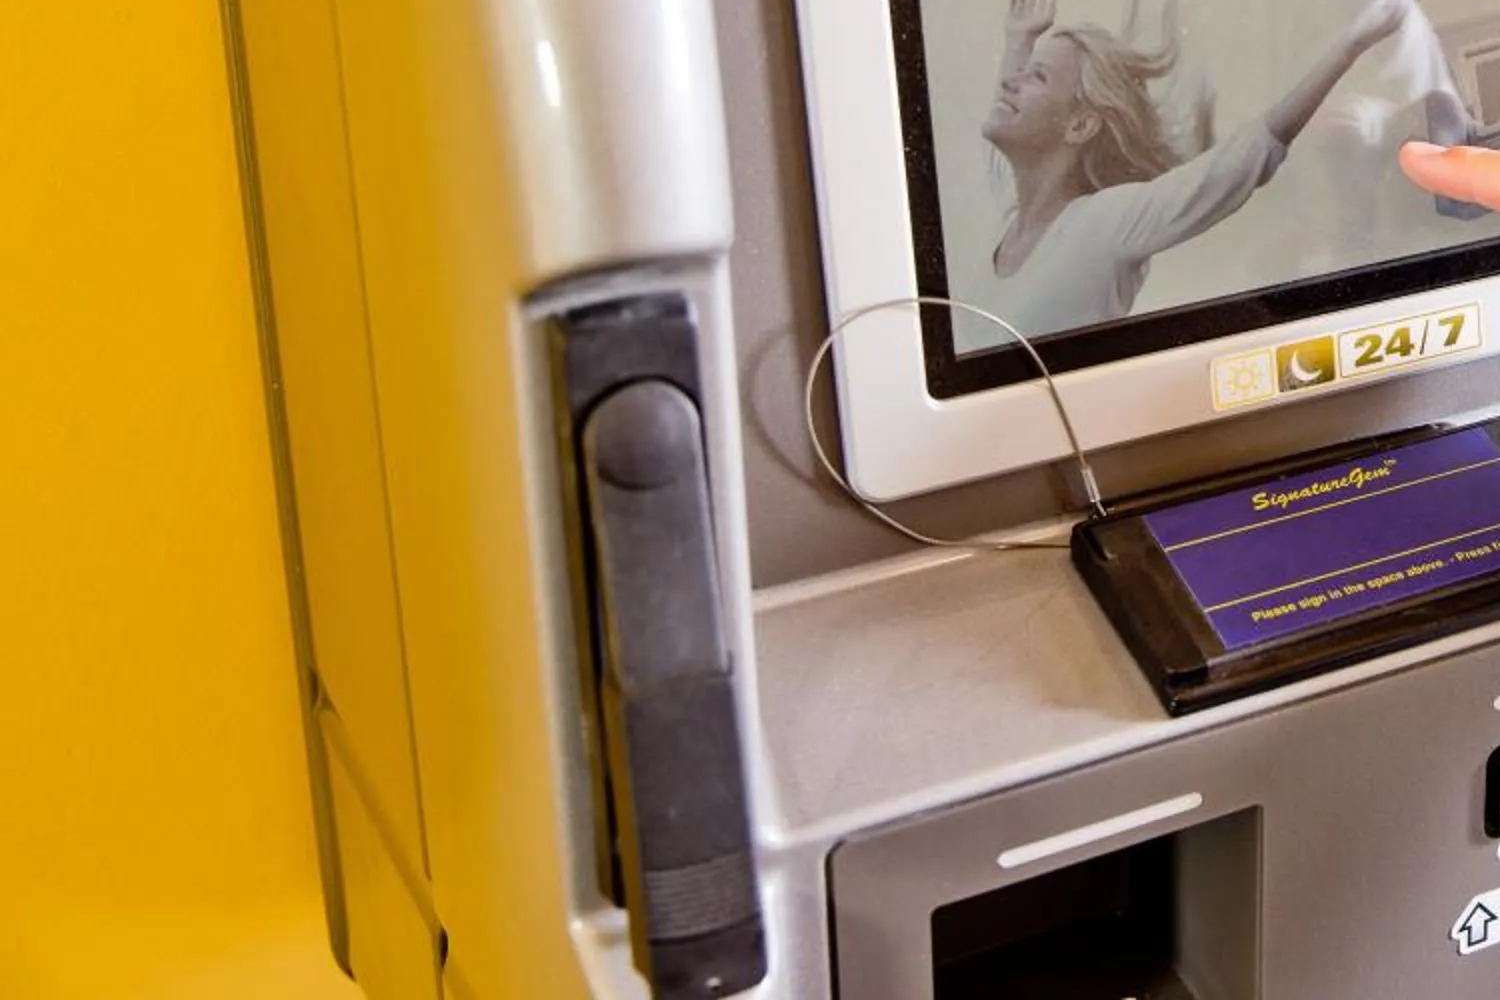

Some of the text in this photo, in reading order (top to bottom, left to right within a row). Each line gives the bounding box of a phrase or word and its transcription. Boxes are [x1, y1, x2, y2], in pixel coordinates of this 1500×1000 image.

[1353, 312, 1465, 368] 24/7
[1251, 602, 1297, 623] Please
[1298, 594, 1327, 609] sign
[1327, 588, 1343, 600] in
[1343, 582, 1366, 596] the
[1367, 571, 1405, 590] space
[1406, 559, 1449, 577] above.
[1455, 545, 1492, 562] Press
